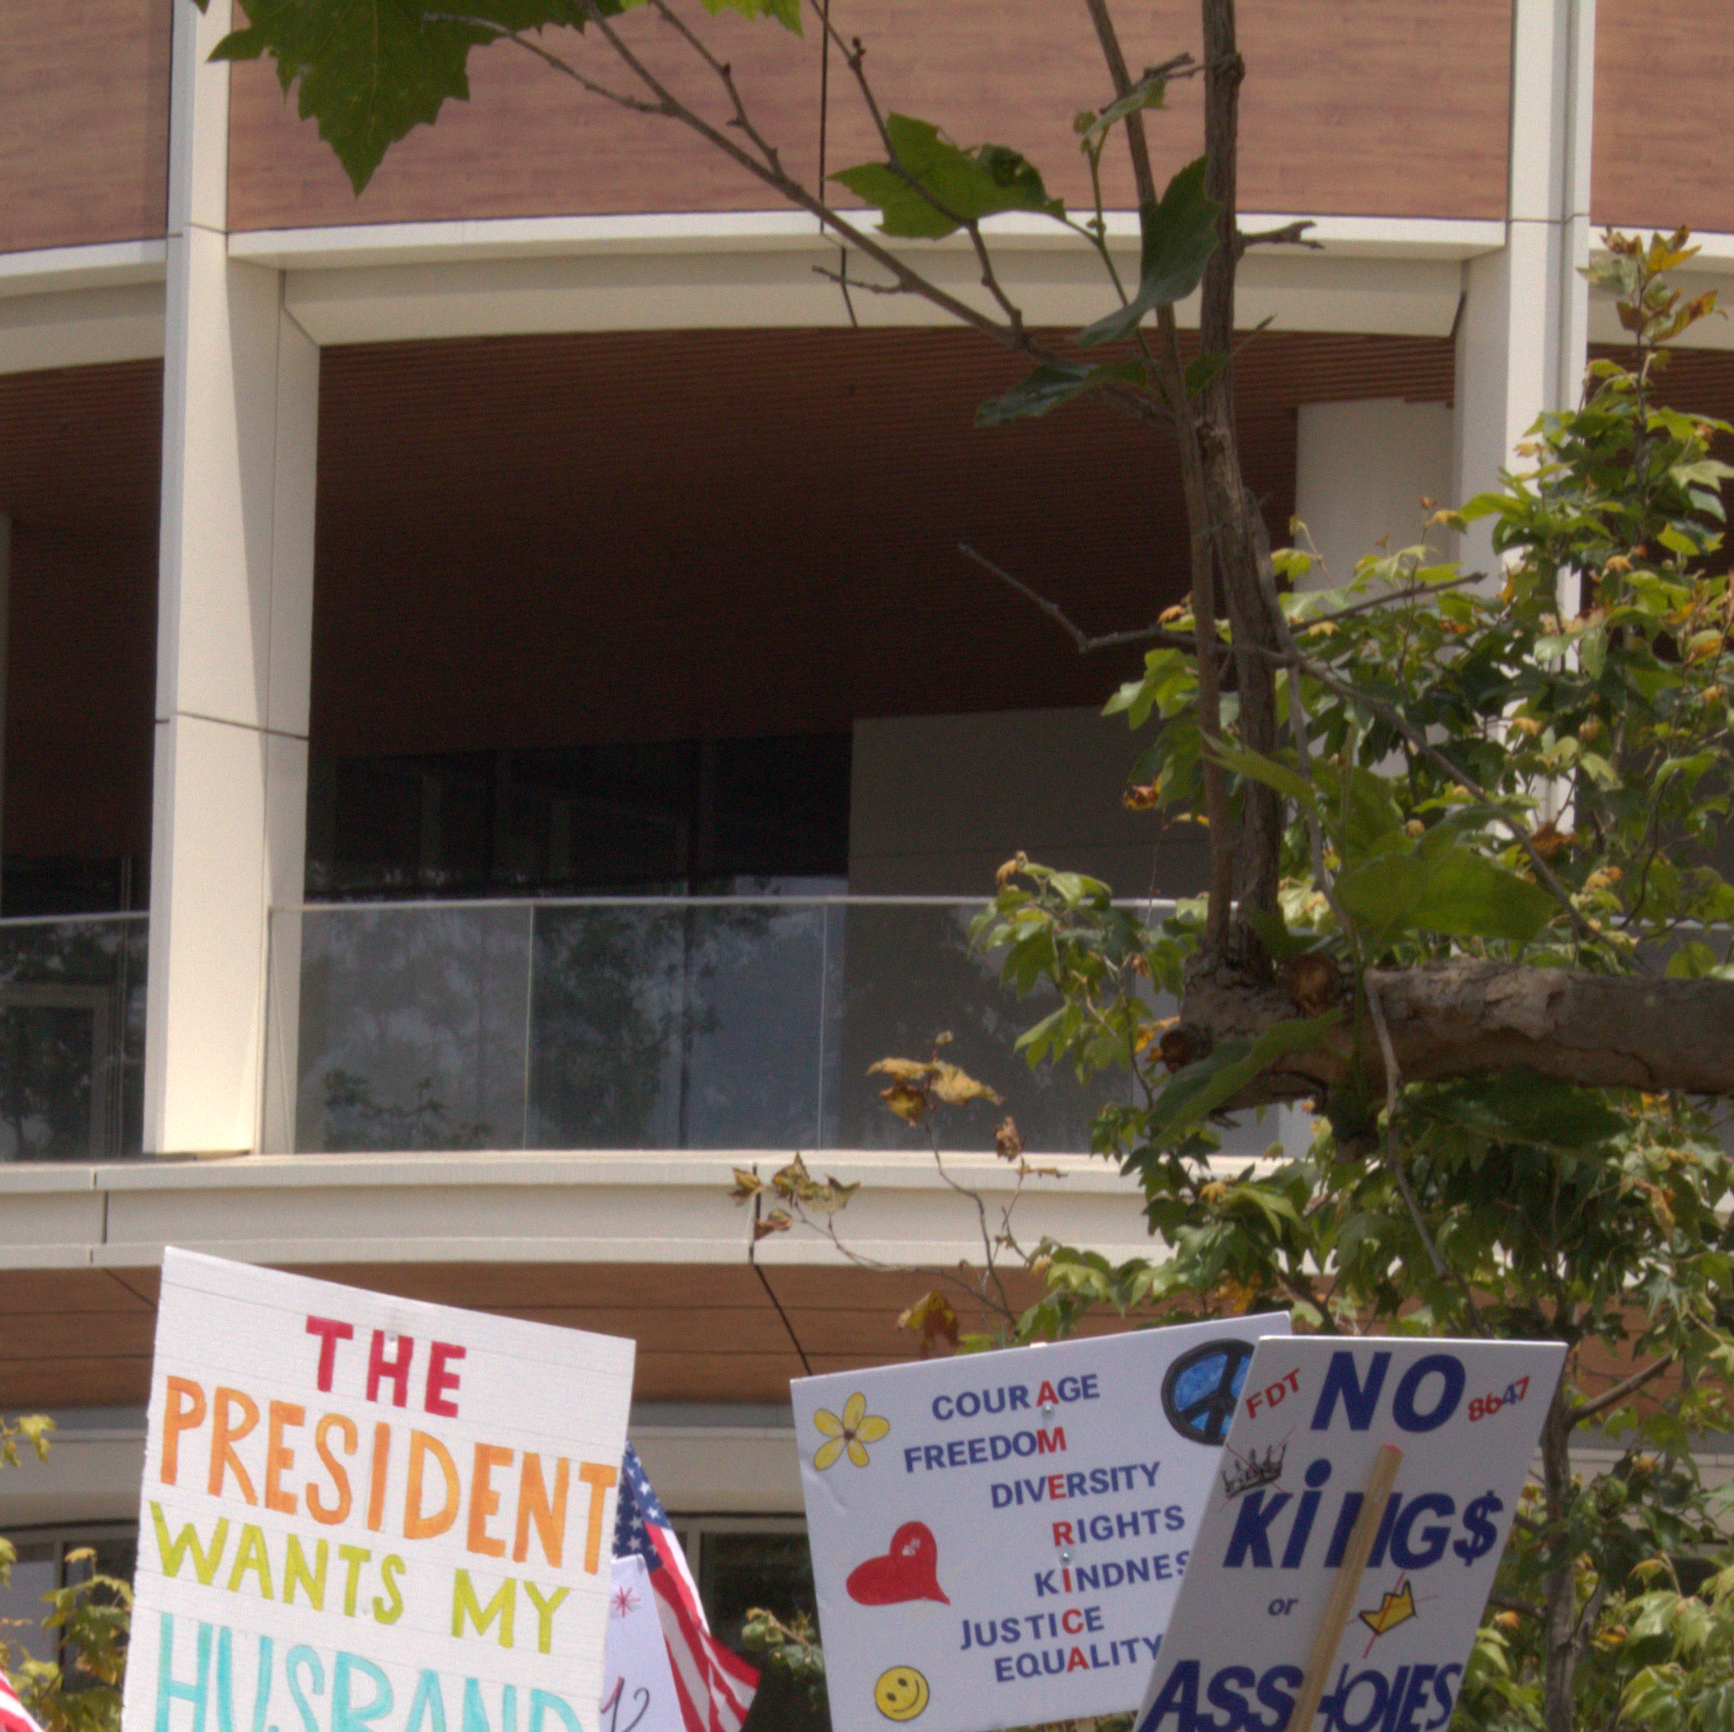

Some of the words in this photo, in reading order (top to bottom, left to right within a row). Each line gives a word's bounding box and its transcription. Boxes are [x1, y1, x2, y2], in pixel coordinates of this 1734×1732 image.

[306, 1315, 467, 1418] THE
[931, 1373, 1100, 1422] COURAGE
[1245, 1368, 1301, 1419] FDT
[1310, 1351, 1466, 1433] NO
[1467, 1375, 1532, 1423] 8647
[159, 1375, 618, 1575] PRESIDENT
[903, 1427, 1068, 1475] FREEDOM
[990, 1461, 1163, 1510] DIVERSITY
[1052, 1504, 1186, 1549] RIGHTS
[150, 1501, 407, 1626] WANTS
[451, 1568, 571, 1655] MY
[1034, 1549, 1191, 1598] KINDNES
[959, 1605, 1106, 1652] JUSTICE
[1268, 1597, 1299, 1617] or
[994, 1632, 1167, 1684] EQUALITY
